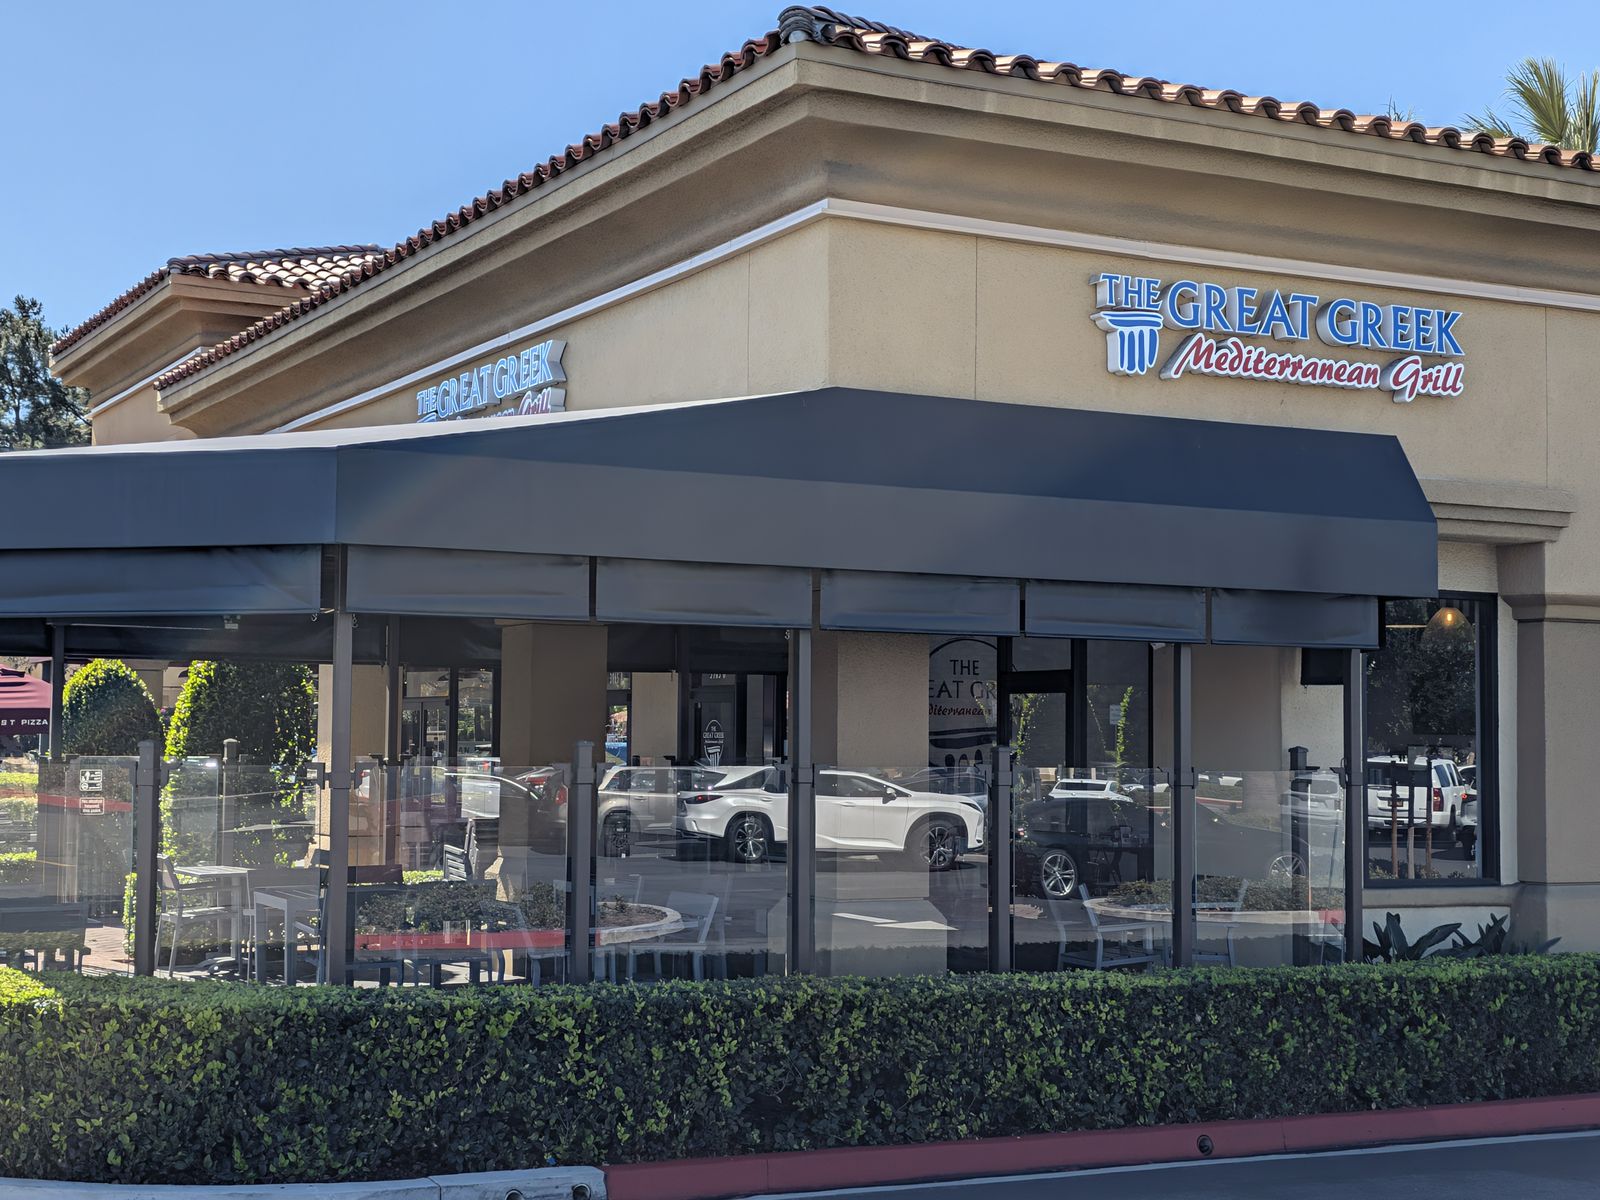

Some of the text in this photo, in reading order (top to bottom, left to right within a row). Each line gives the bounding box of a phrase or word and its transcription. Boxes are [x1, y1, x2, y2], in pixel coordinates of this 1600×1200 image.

[1099, 273, 1465, 356] THE GREAT GREEK
[416, 340, 553, 419] THE GREAT GREEK
[1171, 333, 1465, 403] Mediterranean Grill
[950, 660, 980, 676] THE
